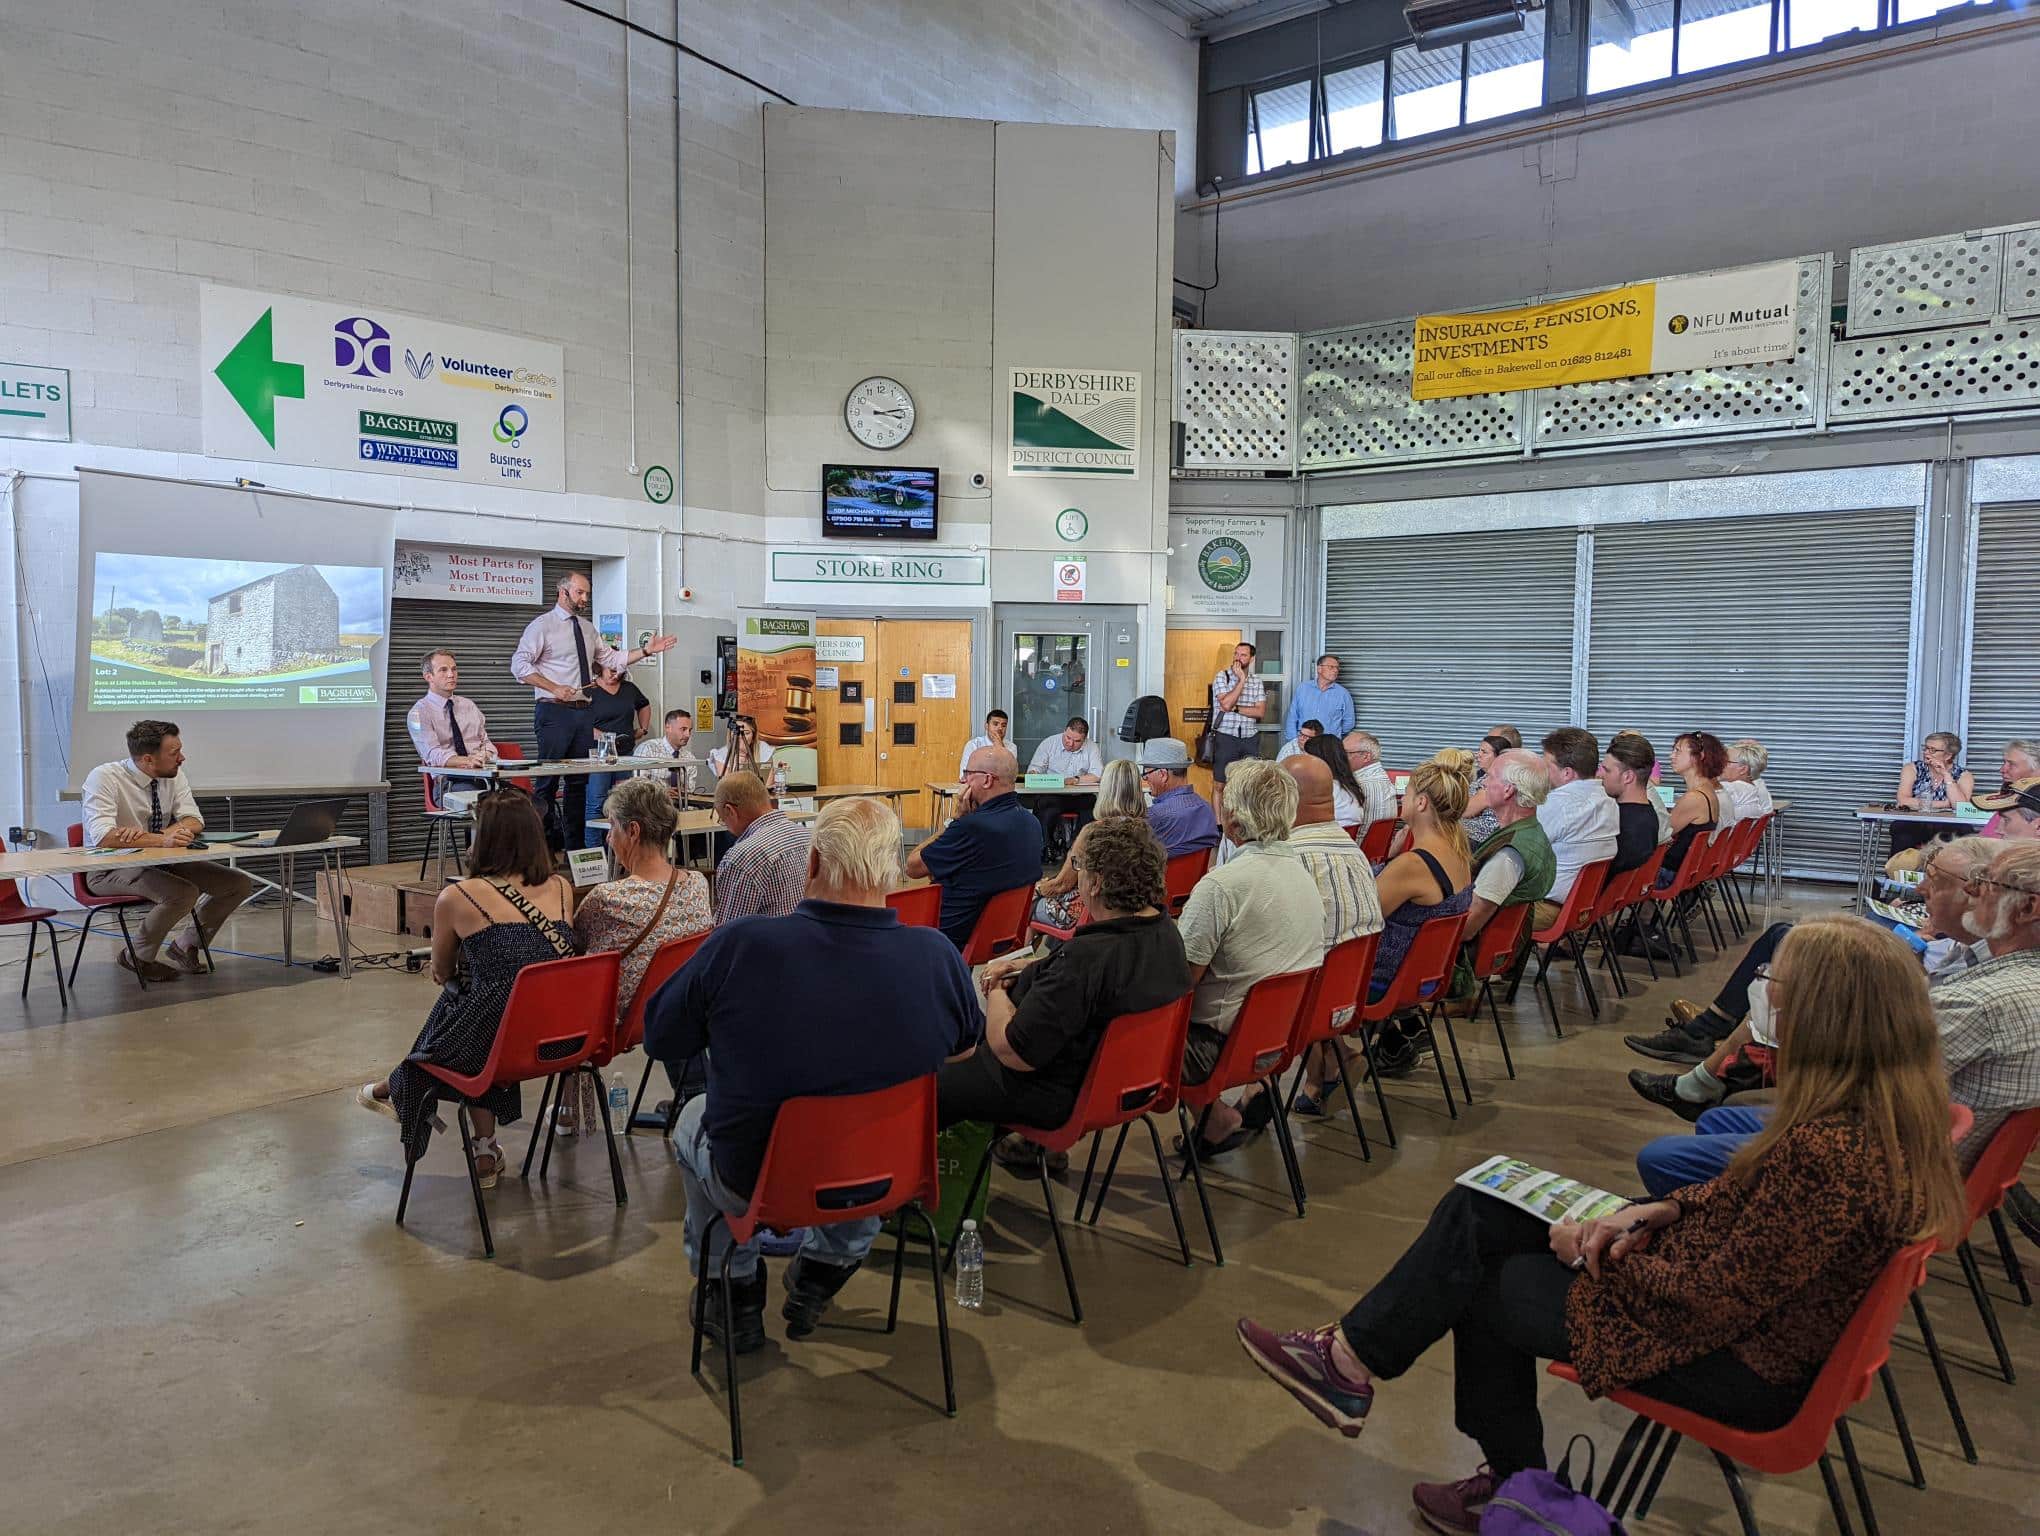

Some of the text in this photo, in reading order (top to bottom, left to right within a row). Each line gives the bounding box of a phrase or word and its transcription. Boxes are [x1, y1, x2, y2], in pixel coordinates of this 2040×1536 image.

[1418, 300, 1641, 343] INSURANCE, PENSIONS,
[1693, 304, 1789, 329] NFU Mutual
[1417, 334, 1548, 363] INVESTMENTS
[1731, 346, 1761, 357] about
[441, 356, 514, 379] Volunteer
[1416, 348, 1633, 382] Call our office in Bakewell on 01629 812481
[323, 379, 404, 397] Derbyshire Dales CVS
[877, 386, 886, 394] 12
[1013, 372, 1136, 392] DERBYSHIRE
[494, 383, 552, 399] Derbyshire Dales
[866, 388, 873, 396] 11
[1051, 391, 1101, 406] DALES
[365, 413, 454, 437] BAGSHAWS
[375, 443, 456, 462] WINTERTONS
[490, 452, 532, 468] Business
[1013, 450, 1135, 465] DISTRICT COUNCIL
[501, 467, 523, 479] Link
[1185, 517, 1225, 527] Supporting
[1227, 518, 1257, 526] Farmers
[1187, 527, 1200, 535] the
[1225, 528, 1265, 537] Community
[448, 554, 534, 570] Most Parts for
[816, 559, 943, 579] STORE RING
[449, 569, 534, 585] Most Tractors
[449, 583, 534, 597] & Farm Machinery
[762, 620, 806, 631] BAGSHAWS
[840, 640, 863, 648] DROP
[822, 648, 850, 657] CLINIC
[320, 688, 372, 697] BAGSHAWS
